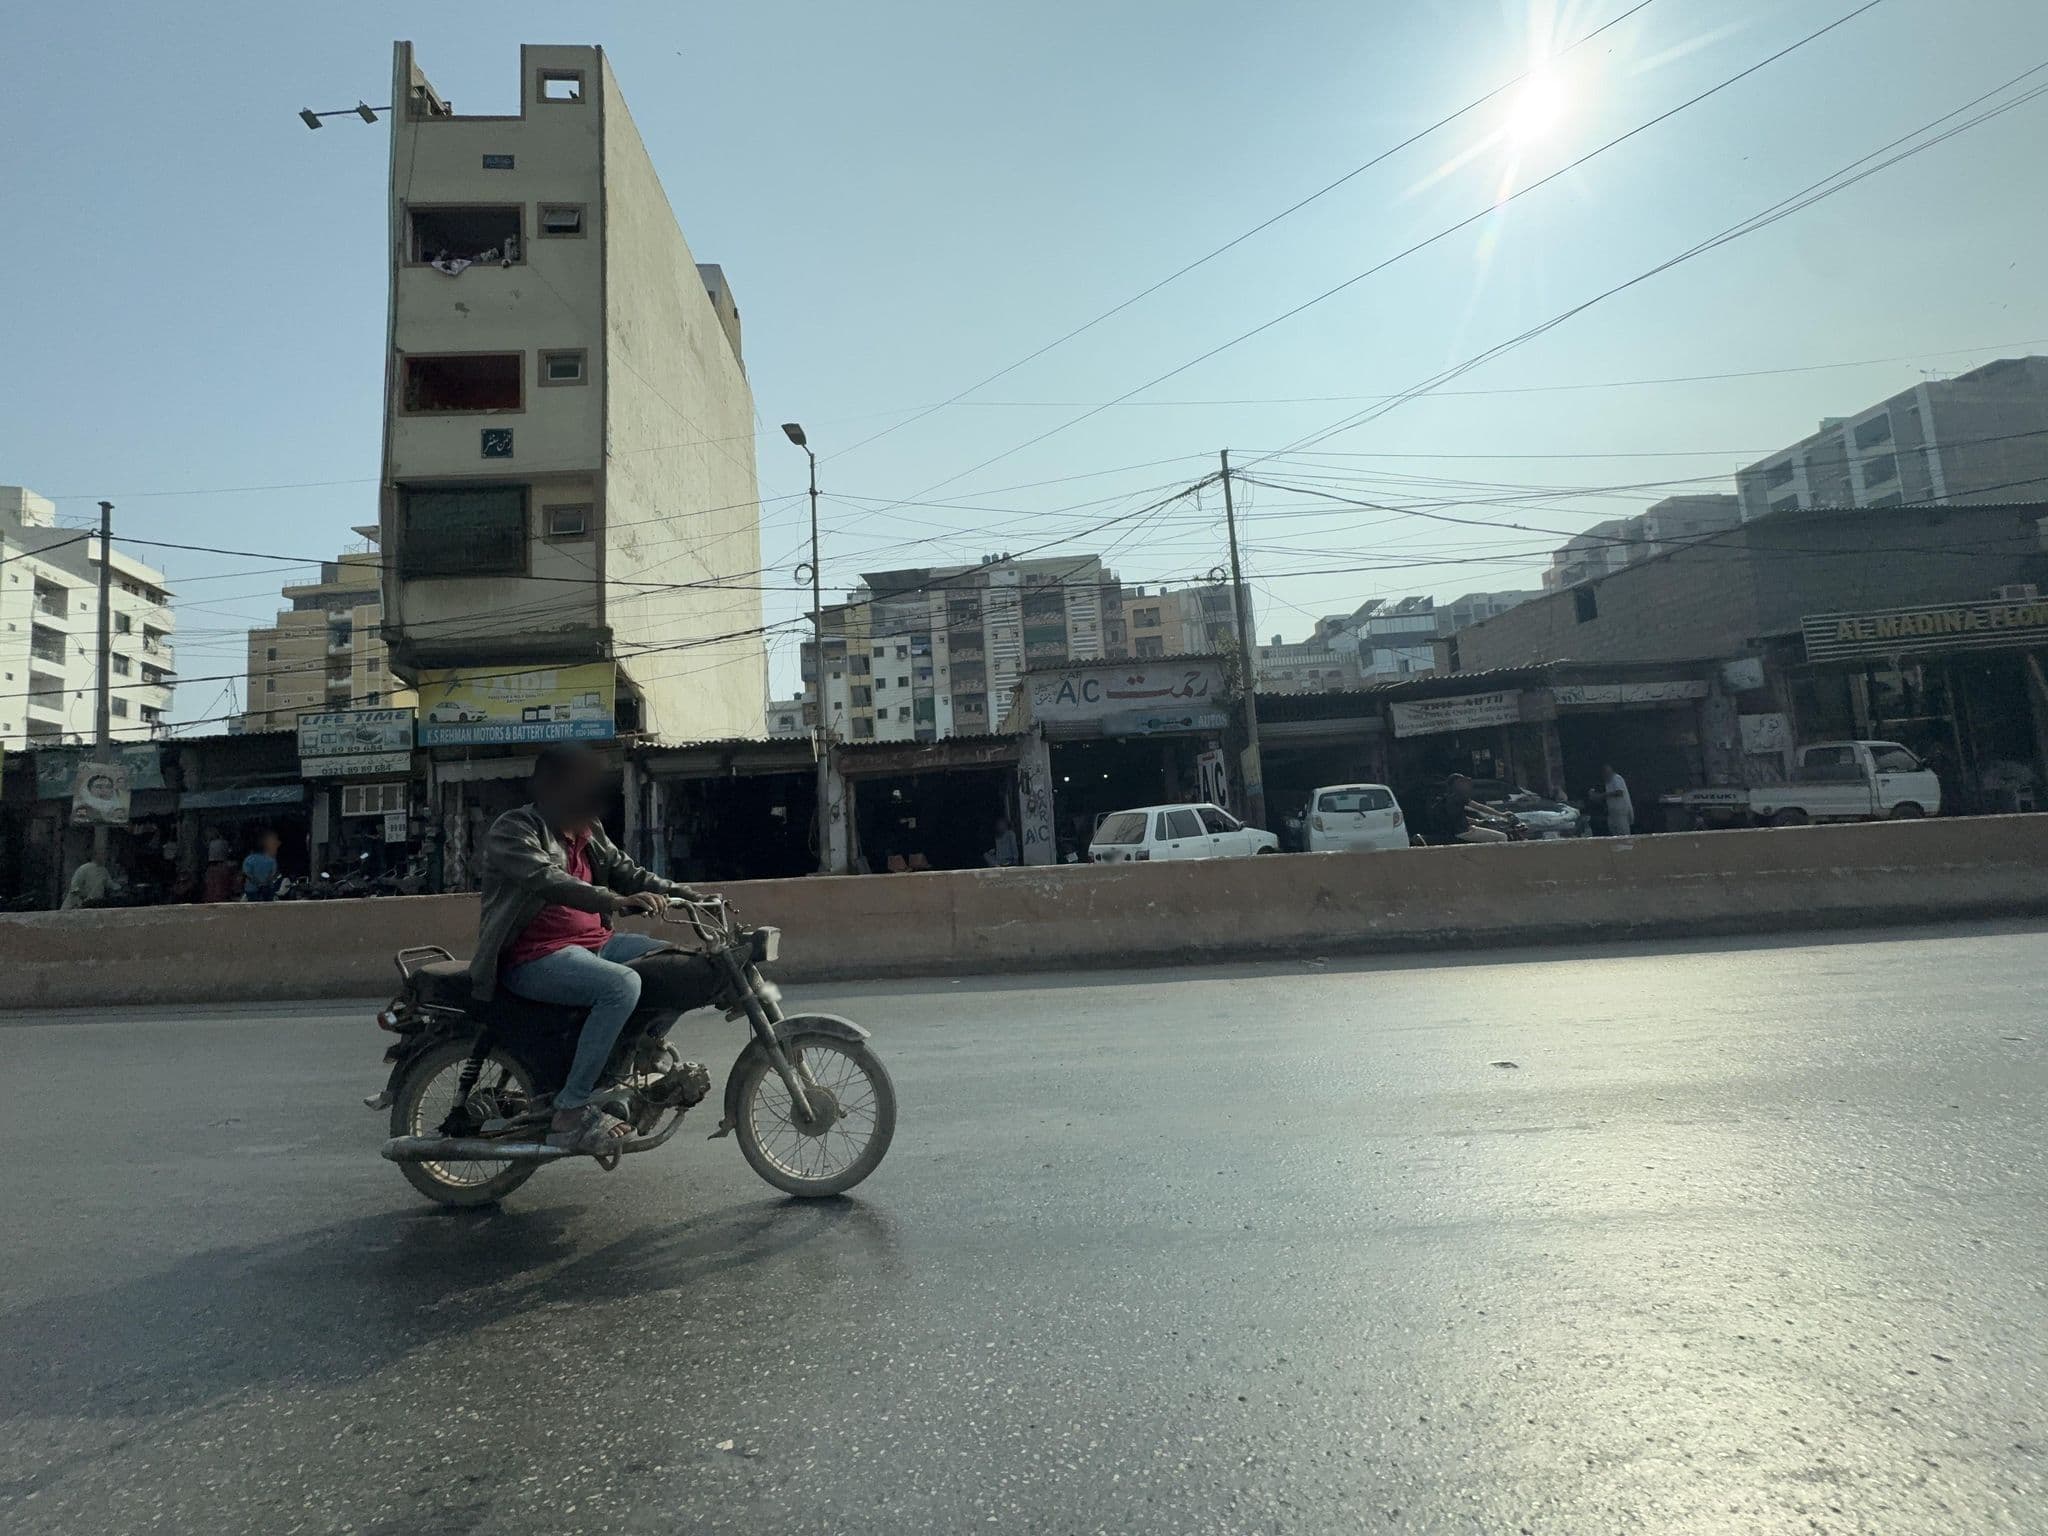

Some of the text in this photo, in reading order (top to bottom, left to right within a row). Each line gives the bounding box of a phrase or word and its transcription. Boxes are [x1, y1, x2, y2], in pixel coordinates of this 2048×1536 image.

[1875, 611, 1978, 638] MADINA
[1107, 671, 1208, 699] رحمت
[303, 710, 407, 725] LIFE TIME
[1199, 712, 1227, 729] AUTOS
[440, 728, 472, 743] REHMAN
[473, 726, 504, 741] MOTORS
[505, 725, 511, 739] &
[512, 724, 544, 739] BATTERY
[546, 722, 573, 738] CENTRE
